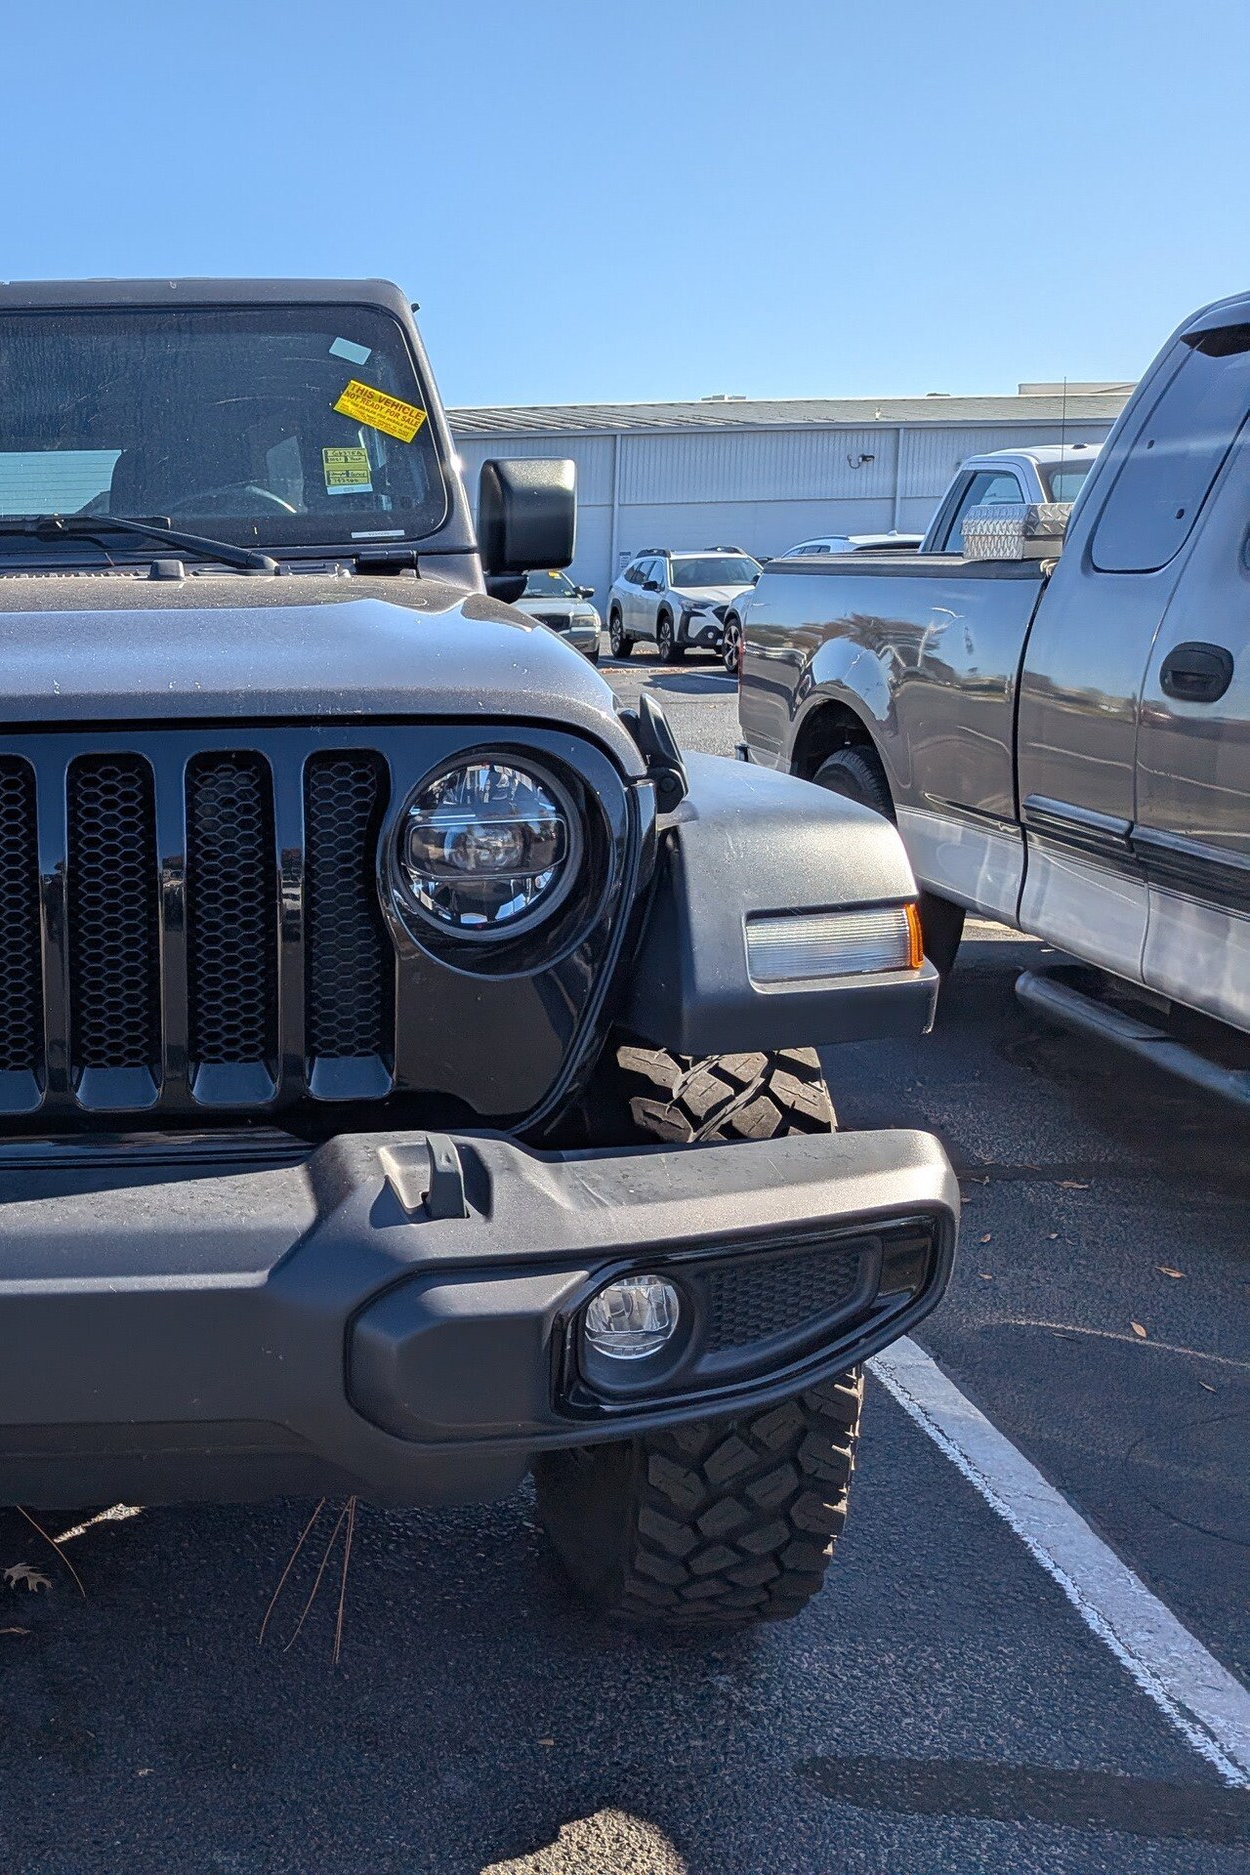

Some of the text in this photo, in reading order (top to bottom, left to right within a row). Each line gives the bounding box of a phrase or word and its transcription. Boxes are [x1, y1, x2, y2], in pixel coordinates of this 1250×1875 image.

[344, 391, 359, 402] NOT
[361, 398, 385, 413] READY
[385, 408, 401, 418] FOR
[401, 415, 420, 427] SALE
[350, 384, 375, 399] THIS
[378, 394, 424, 420] VEHICLE
